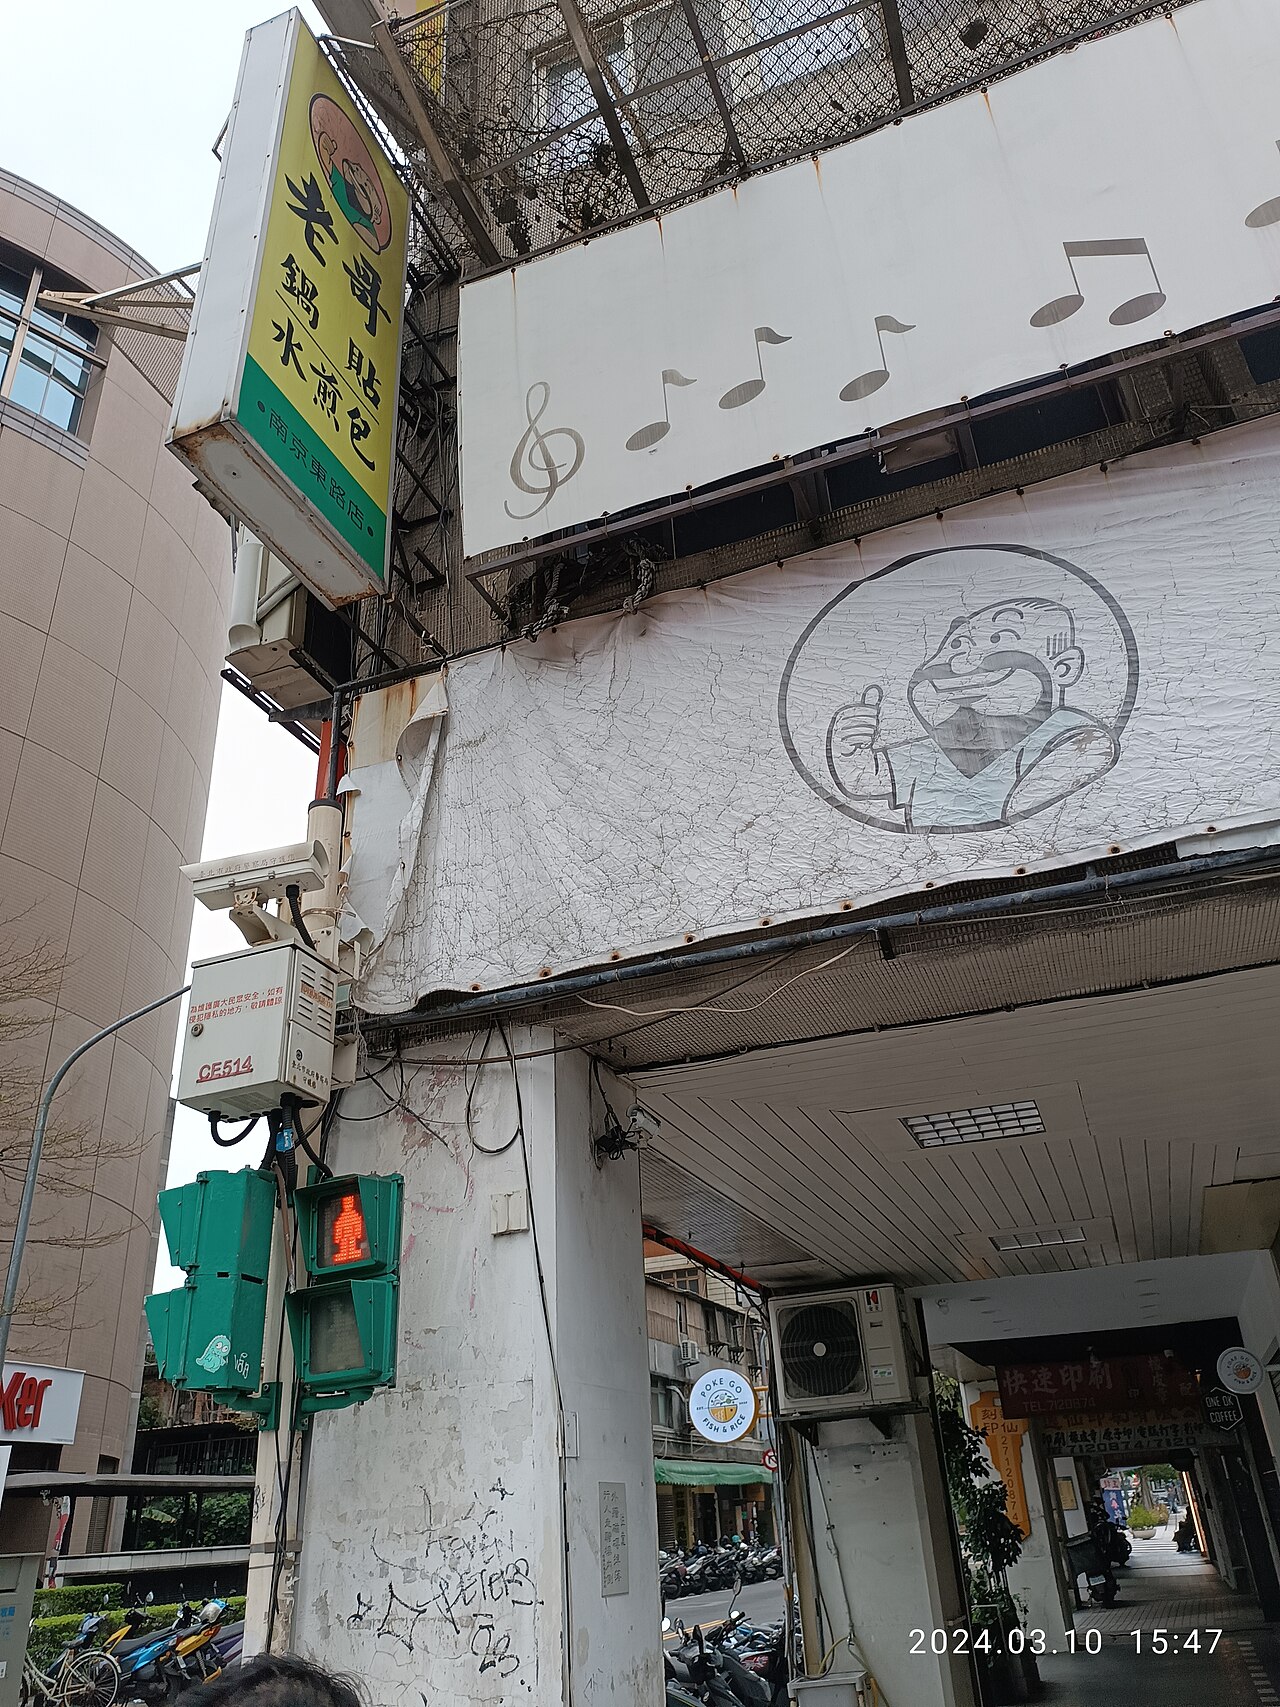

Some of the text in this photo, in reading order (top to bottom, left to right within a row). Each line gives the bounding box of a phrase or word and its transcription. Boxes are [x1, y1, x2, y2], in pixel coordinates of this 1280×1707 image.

[284, 170, 391, 338] 老哥
[279, 252, 382, 411] 鍋貼
[271, 317, 377, 471] 水煎包
[268, 411, 364, 532] 南京東路店
[198, 1055, 253, 1081] CE514
[700, 1377, 742, 1398] POKE GO
[1003, 1362, 1113, 1396] 快速印刷
[1022, 1401, 1046, 1412] TEL
[1205, 1395, 1234, 1407] ONE OK
[702, 1417, 720, 1433] FISH
[729, 1413, 746, 1431] RICE
[1209, 1410, 1238, 1423] COFFEE
[1001, 1435, 1018, 1521] 27120874
